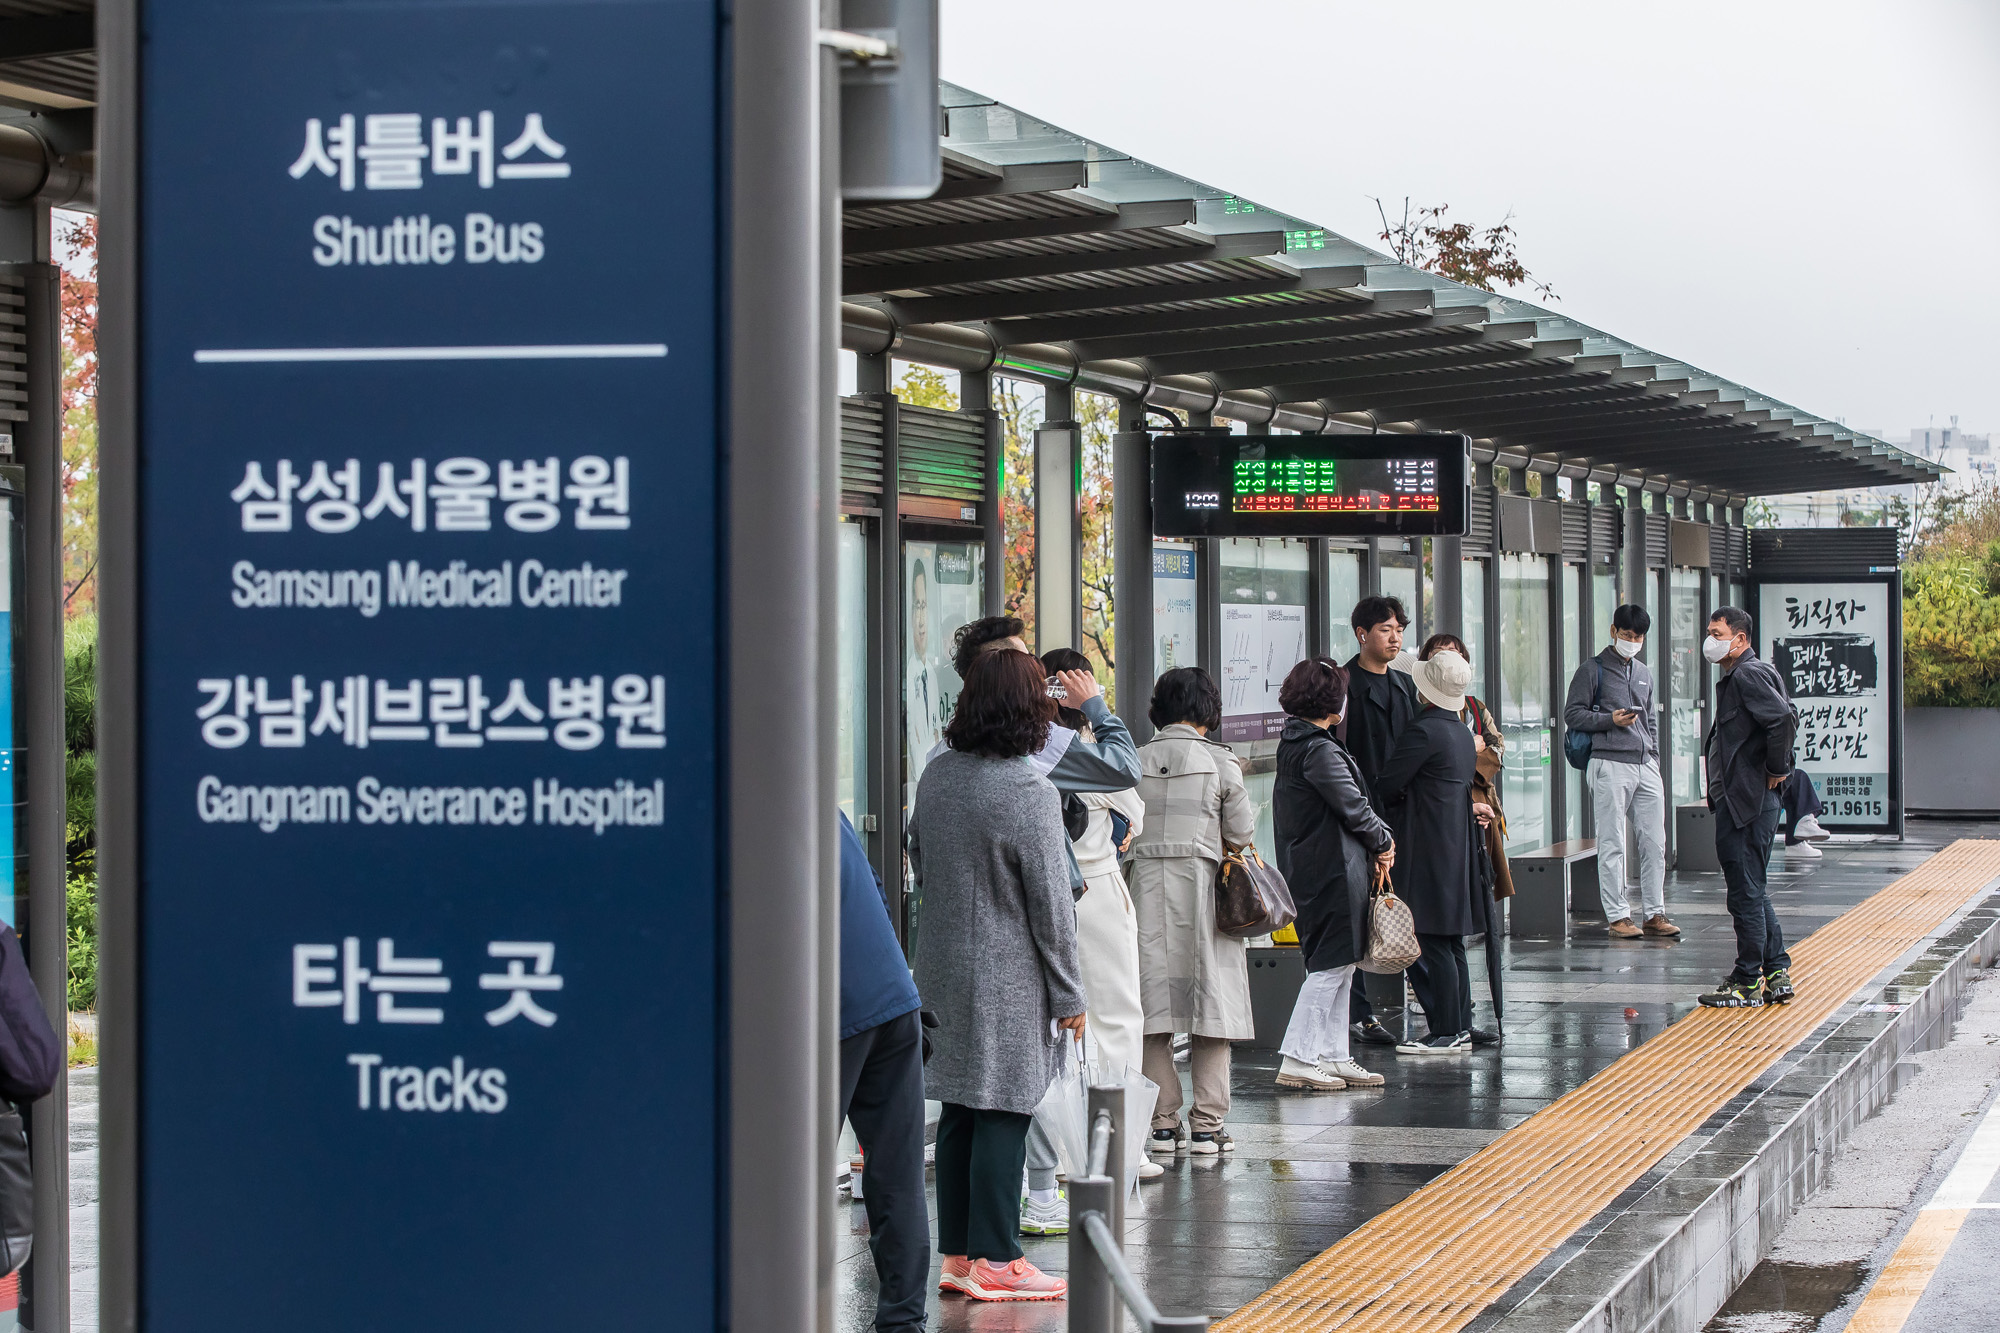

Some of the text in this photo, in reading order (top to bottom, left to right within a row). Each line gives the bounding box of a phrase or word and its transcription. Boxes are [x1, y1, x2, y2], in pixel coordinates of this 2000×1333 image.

[288, 110, 571, 191] 셔틀버스
[313, 213, 545, 267] Shuttle Bus
[231, 455, 631, 533] 삼성서울병원
[231, 559, 627, 618] Samsung Medical Center
[1785, 598, 1866, 629] 퇴직자
[1789, 641, 1833, 669] 폐암
[1792, 663, 1862, 693] 폐질환
[196, 674, 666, 751] 강남세브란스병원
[1794, 732, 1868, 762] 료상담
[197, 775, 664, 836] Gangnam Severance Hospital
[293, 936, 563, 1027] 타는 곳
[347, 1054, 508, 1113] Tracks
